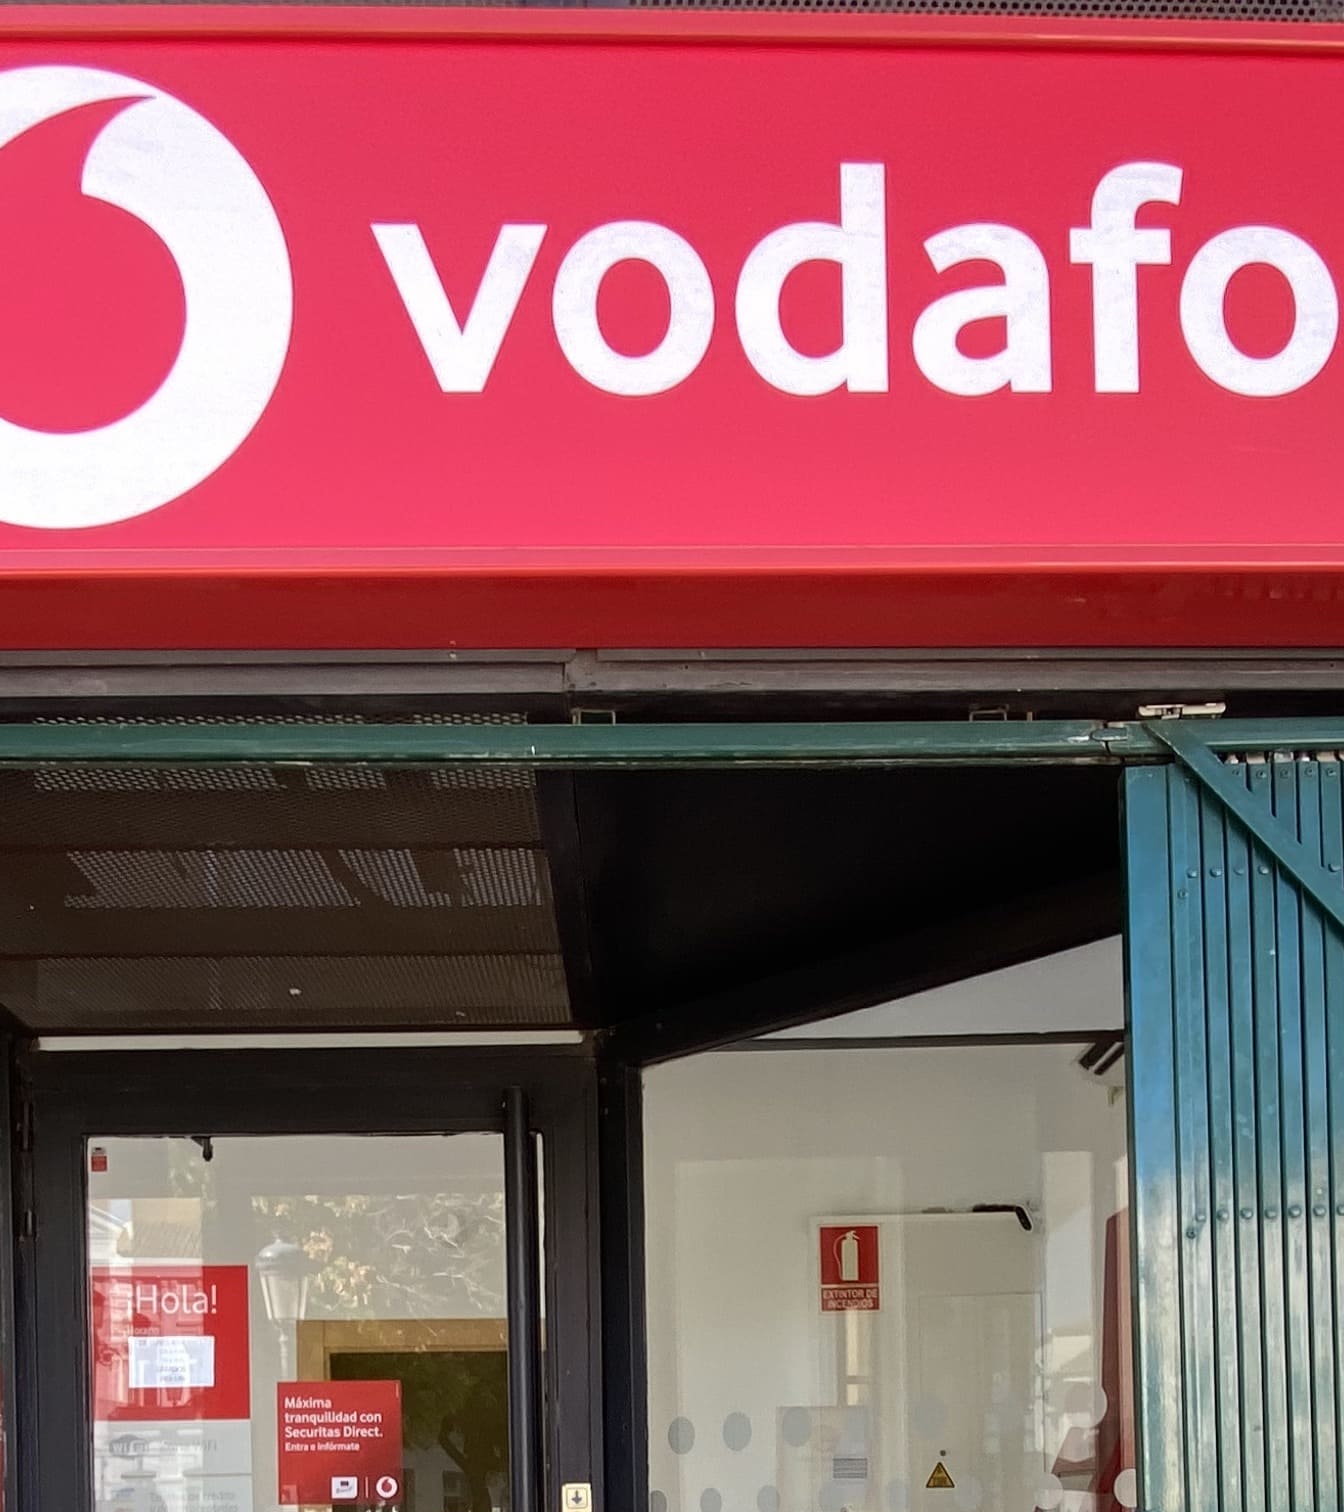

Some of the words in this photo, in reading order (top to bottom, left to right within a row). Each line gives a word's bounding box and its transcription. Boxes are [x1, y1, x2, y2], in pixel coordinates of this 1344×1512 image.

[823, 1289, 864, 1299] EXTINTOR
[284, 1397, 332, 1409] Máxima
[284, 1411, 357, 1425] tranquilidad
[360, 1413, 382, 1423] con
[285, 1426, 341, 1438] Securitas
[343, 1426, 383, 1438] Direct.
[285, 1442, 309, 1452] Entra
[317, 1441, 360, 1451] infórmate
